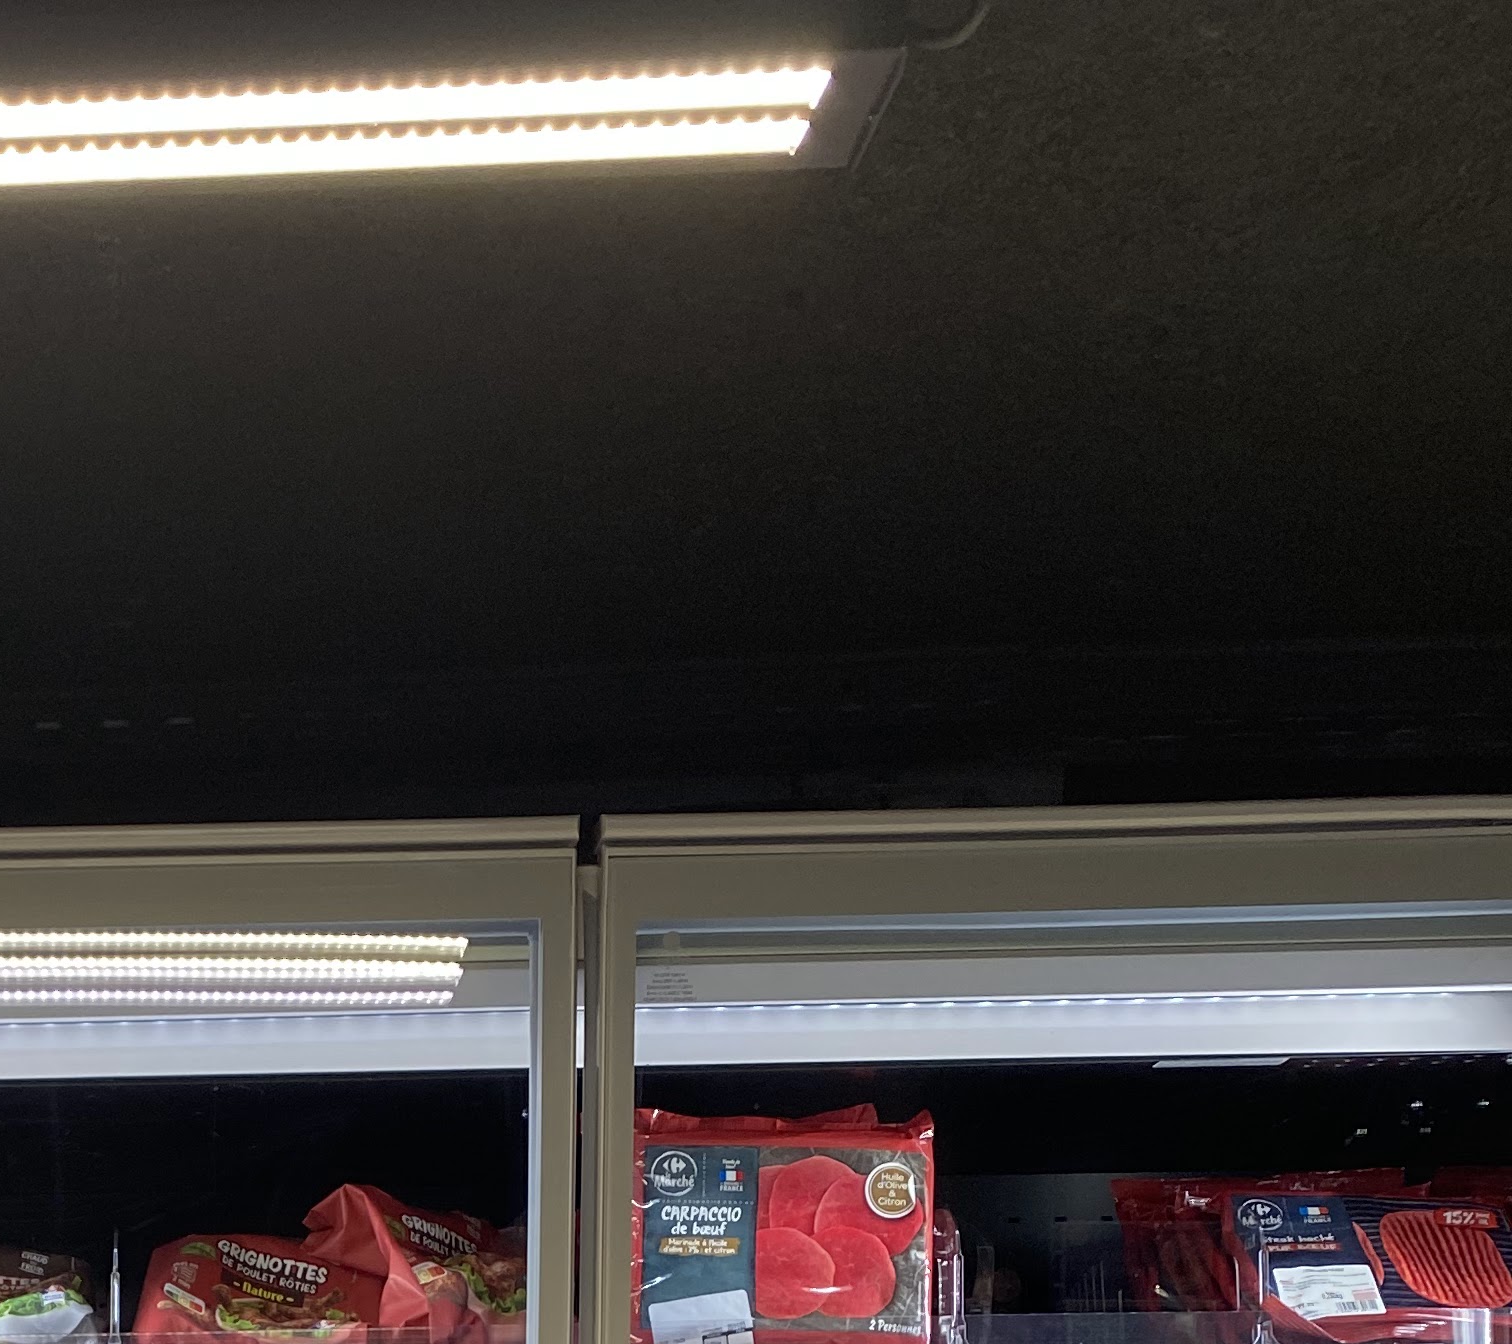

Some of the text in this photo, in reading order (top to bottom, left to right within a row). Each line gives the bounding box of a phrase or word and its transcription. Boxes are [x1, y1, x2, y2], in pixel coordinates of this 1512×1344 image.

[652, 1172, 696, 1189] Marché
[881, 1172, 905, 1182] Huile
[719, 1184, 744, 1192] FRANCE
[877, 1180, 908, 1190] d'Olive
[889, 1189, 896, 1197] &
[877, 1197, 907, 1207] Citron
[660, 1204, 743, 1223] CARPACCIO
[1442, 1210, 1475, 1225] 15%
[401, 1213, 478, 1255] GRIGNOTTES
[670, 1221, 727, 1236] de bœuf
[409, 1231, 421, 1244] DE
[216, 1239, 328, 1284] GRIGNOTTES
[221, 1254, 317, 1294] DE POULET RÔTIES
[242, 1281, 284, 1303] Nature
[869, 1319, 922, 1336] 2 Personnes
